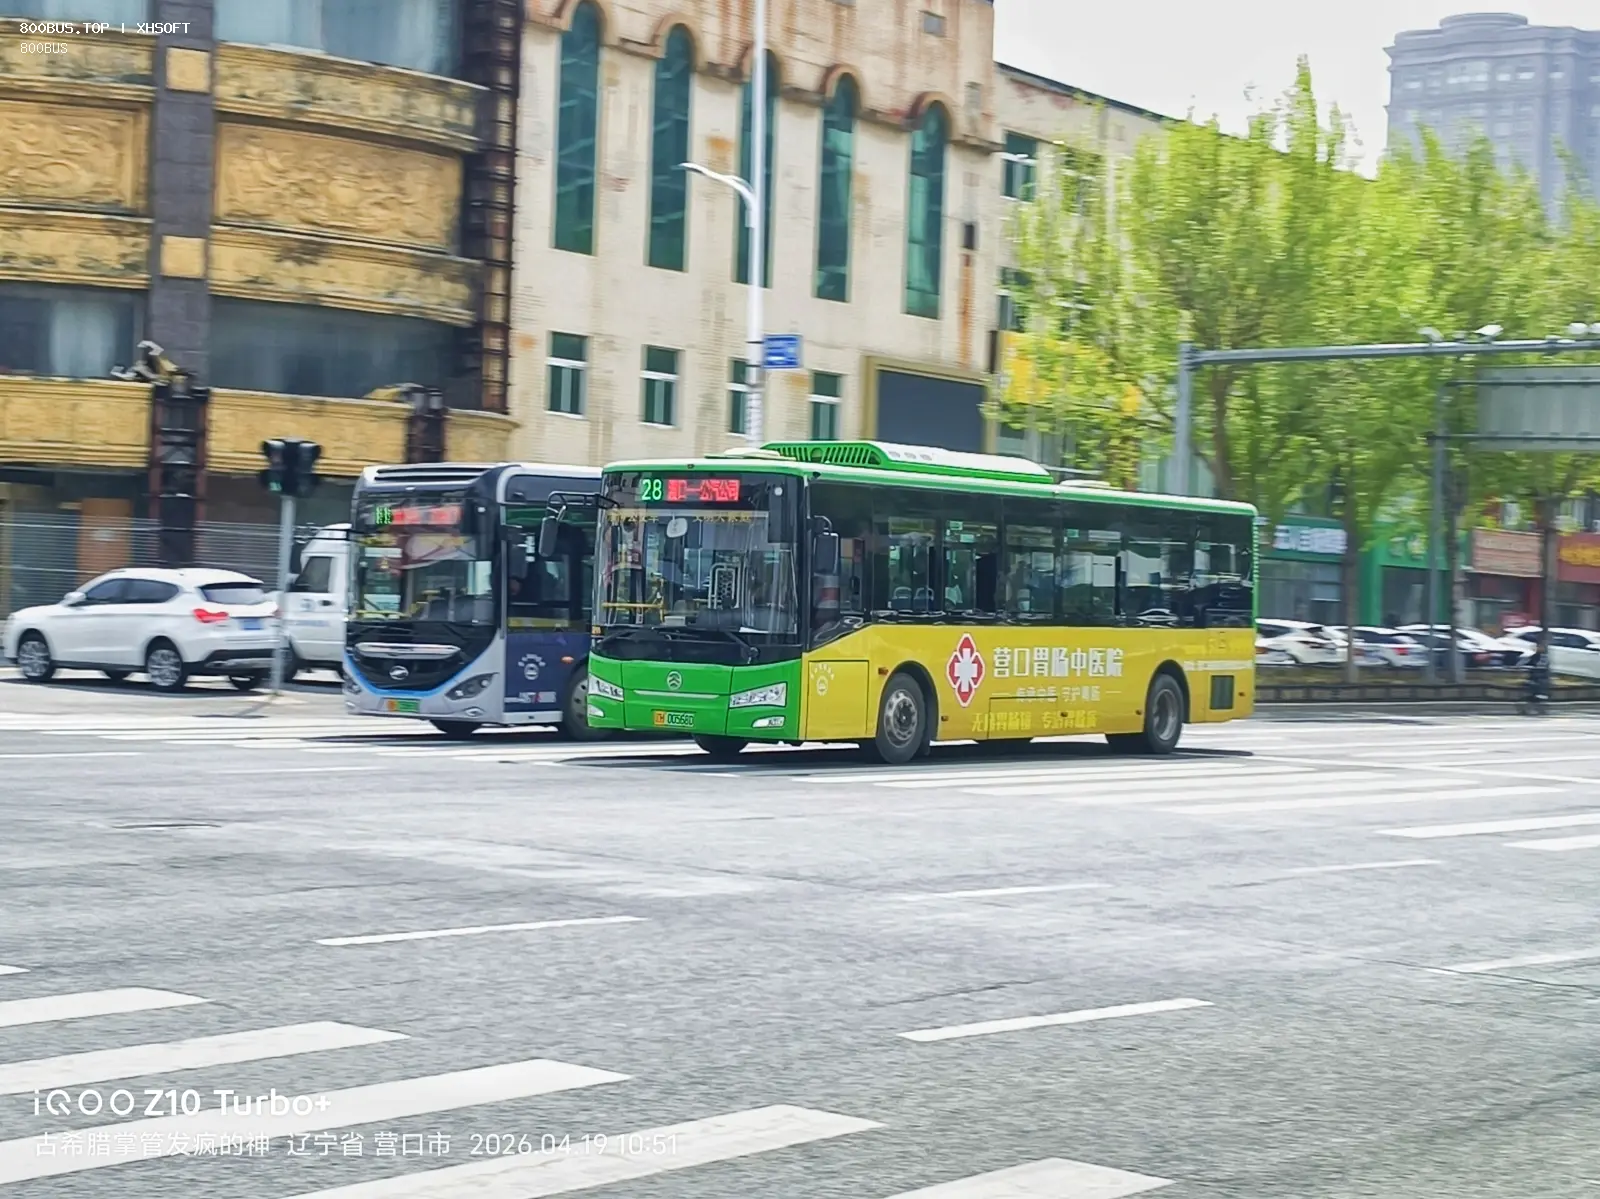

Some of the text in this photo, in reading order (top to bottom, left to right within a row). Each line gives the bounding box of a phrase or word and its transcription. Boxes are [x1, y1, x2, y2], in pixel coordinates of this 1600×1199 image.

[641, 478, 663, 501] 28
[993, 646, 1124, 677] 营口胃肠中医院
